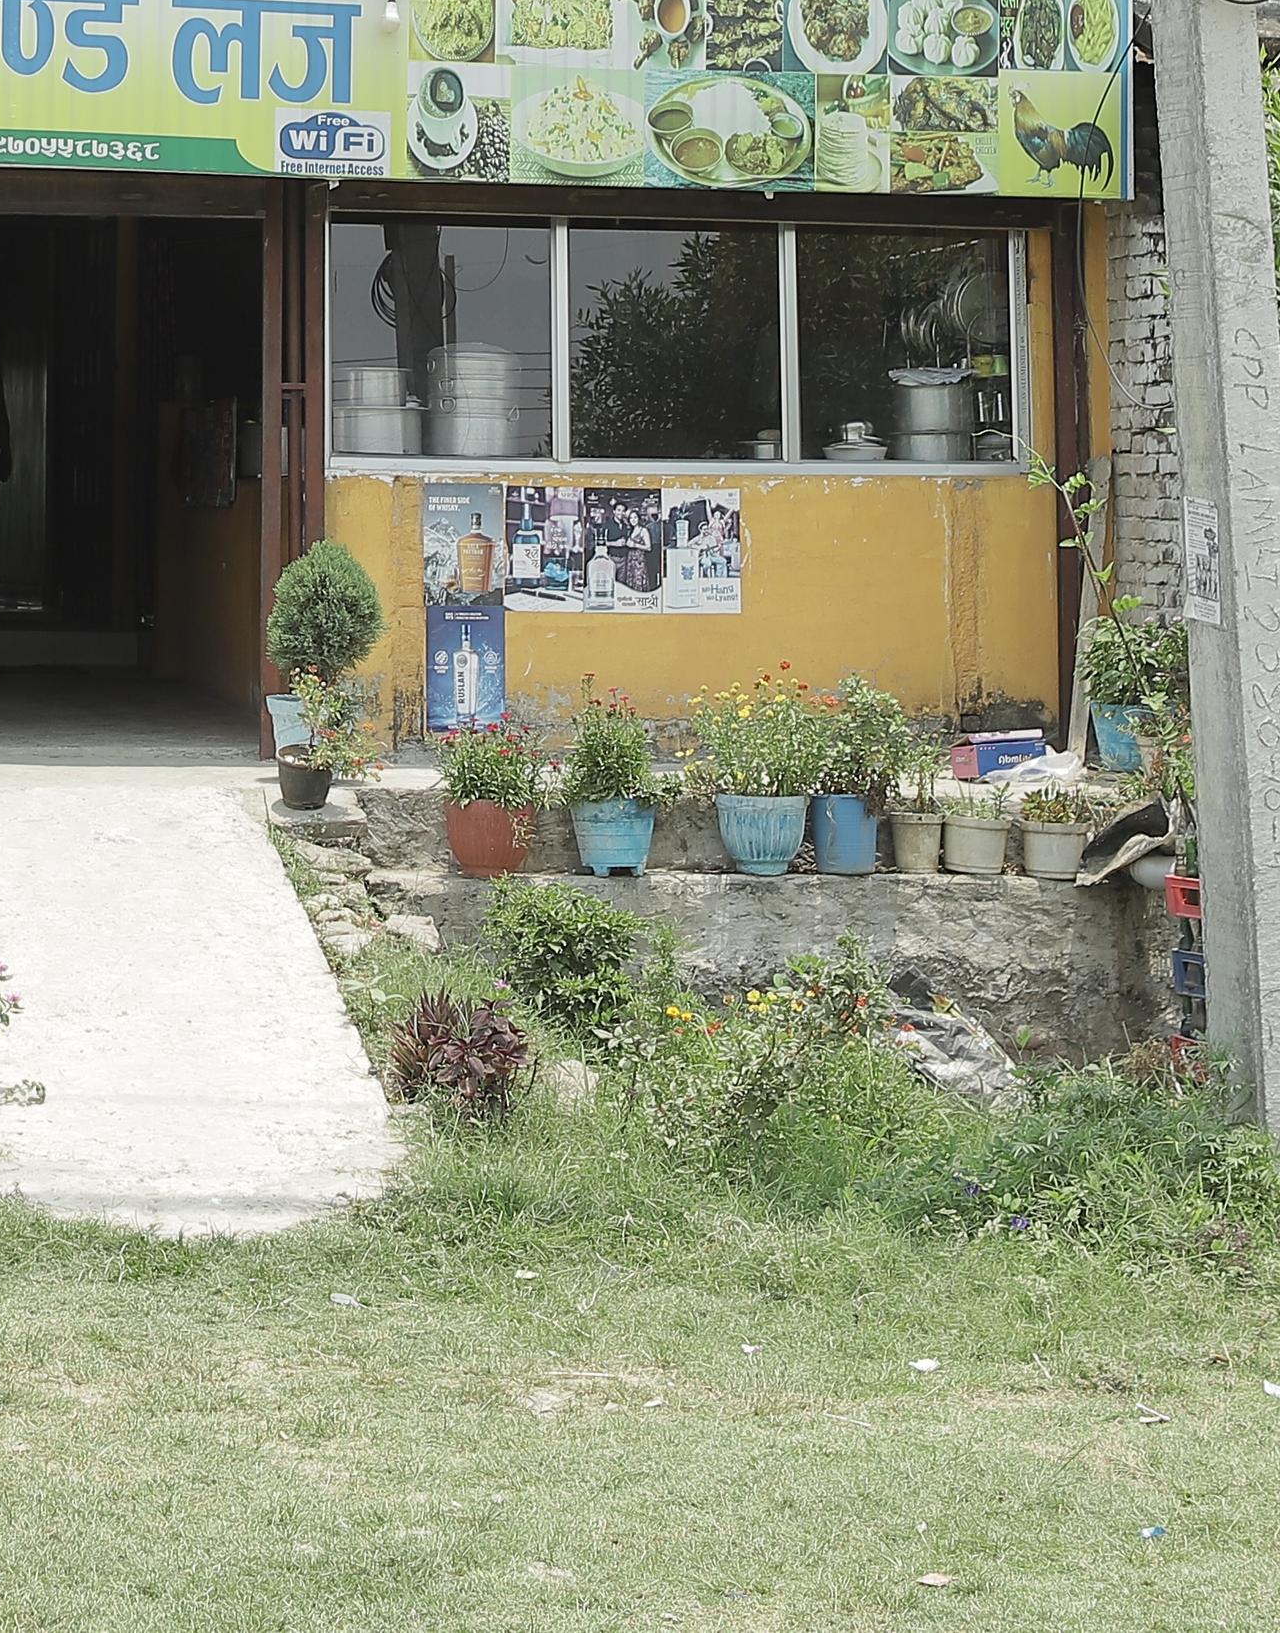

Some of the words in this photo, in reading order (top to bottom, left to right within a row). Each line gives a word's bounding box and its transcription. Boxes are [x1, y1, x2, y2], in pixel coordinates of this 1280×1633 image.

[317, 115, 351, 126] Free
[281, 160, 302, 173] Free
[305, 161, 346, 175] Internet
[348, 163, 384, 176] Access
[457, 671, 465, 704] RUSLAN
